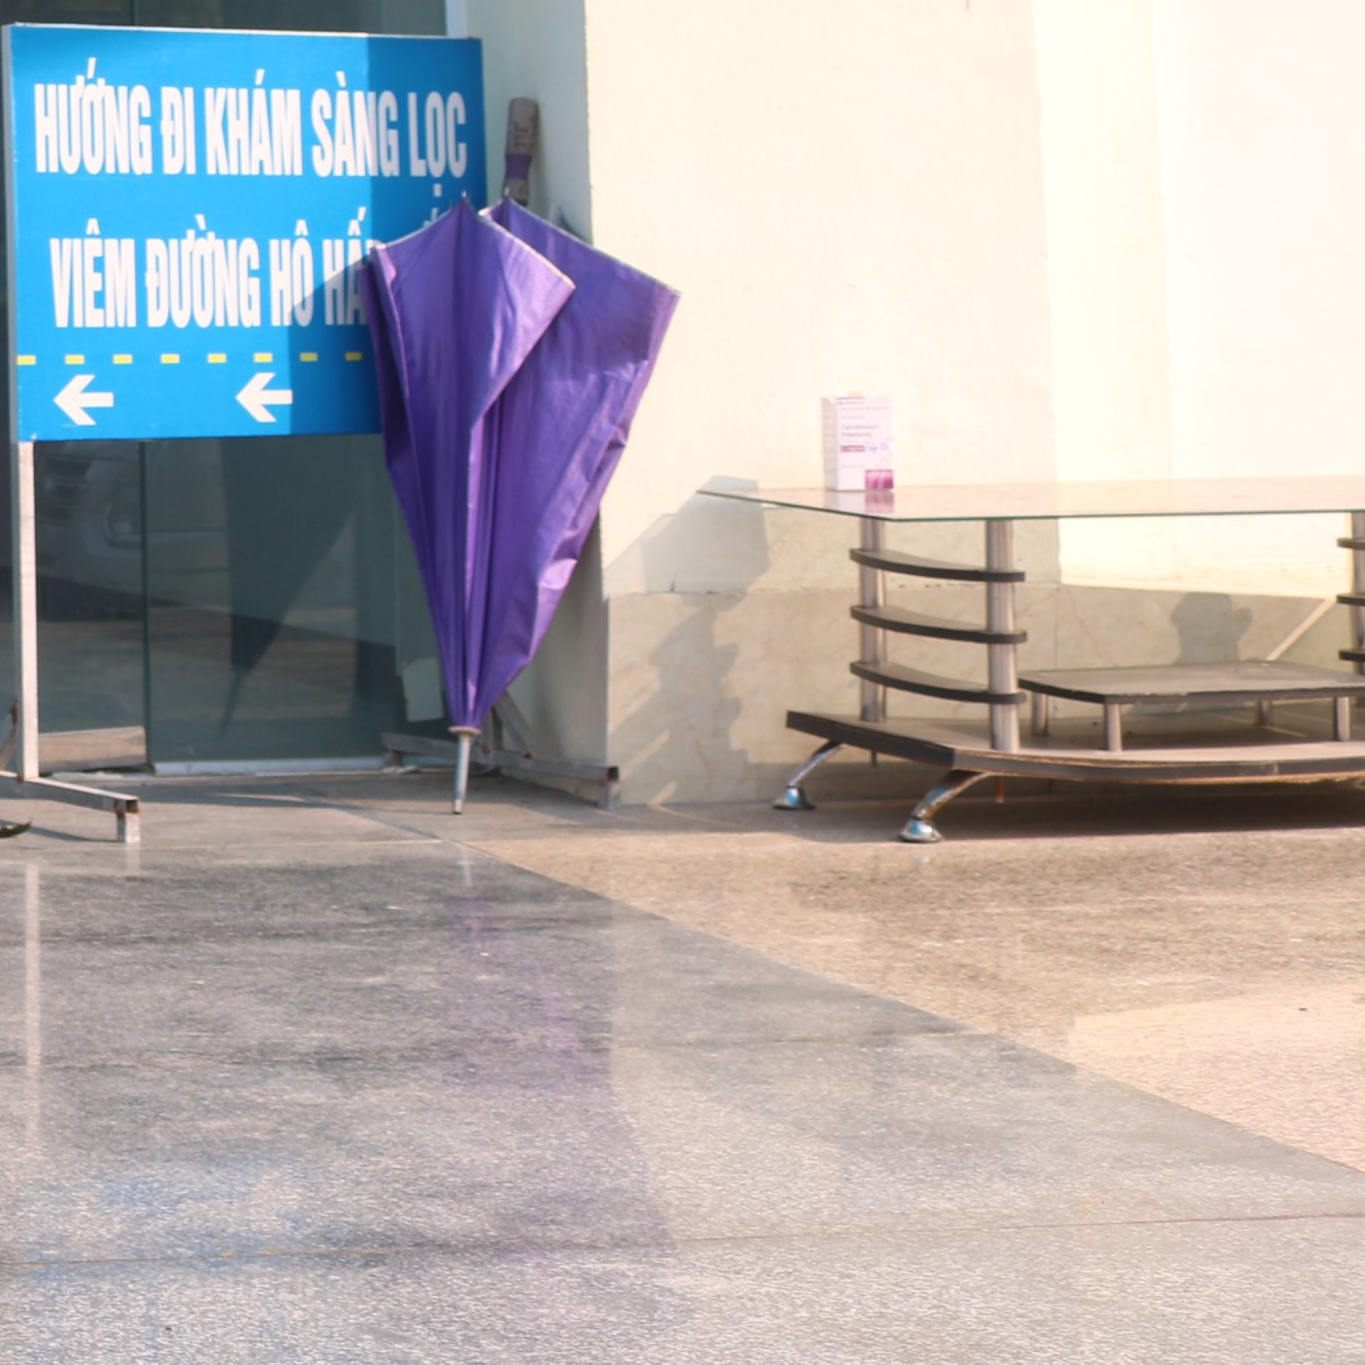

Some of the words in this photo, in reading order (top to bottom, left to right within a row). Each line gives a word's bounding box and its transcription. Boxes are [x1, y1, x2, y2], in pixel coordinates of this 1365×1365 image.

[34, 56, 154, 177] HƯỚNG
[160, 85, 198, 176] ĐI
[204, 68, 304, 177] KHÁM
[310, 70, 400, 179] SÀNG
[408, 91, 468, 198] LỌC
[49, 218, 138, 329] VIÊM
[144, 213, 263, 329] ĐƯỜNG
[269, 219, 315, 328] HÔ
